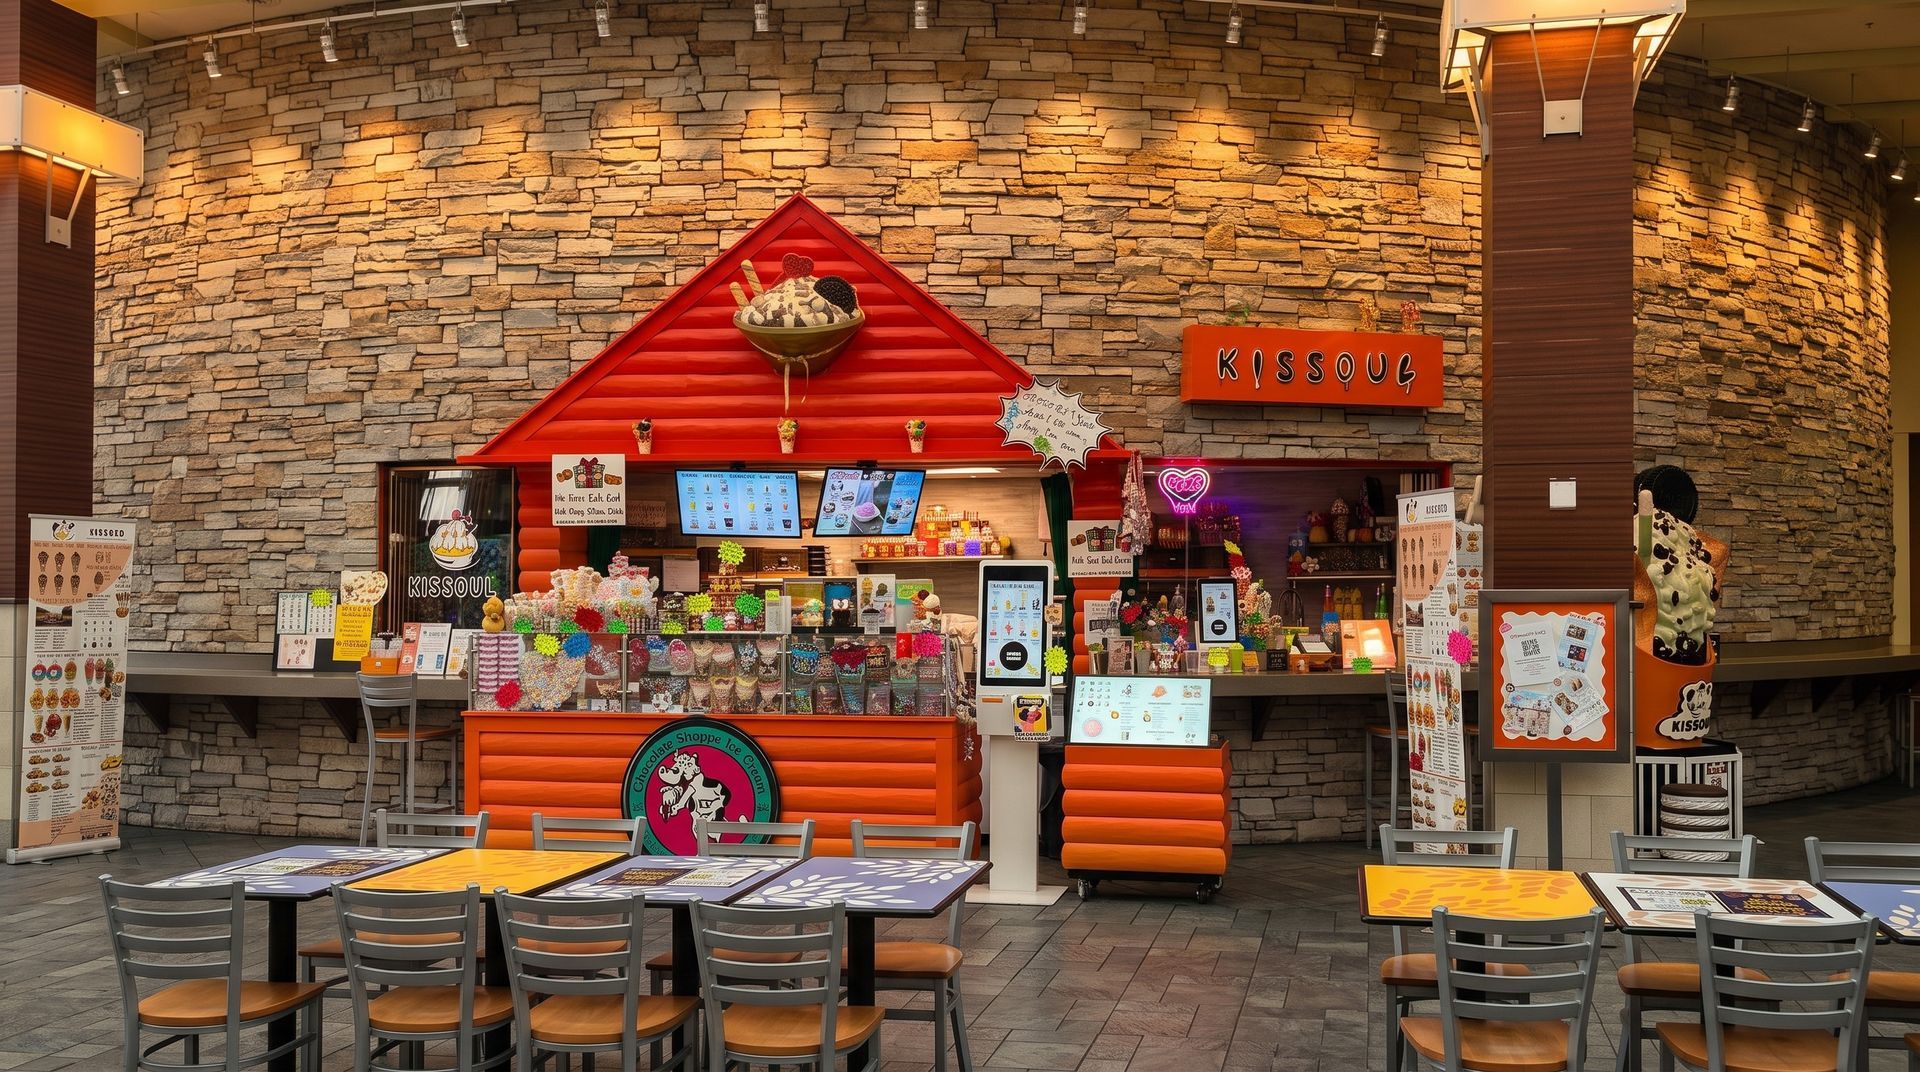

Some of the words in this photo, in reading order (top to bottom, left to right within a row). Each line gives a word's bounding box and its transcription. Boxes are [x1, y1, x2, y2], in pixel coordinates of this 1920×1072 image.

[1217, 347, 1416, 394] KISSOUL
[408, 575, 497, 598] KISSOUL
[633, 740, 673, 793] Chocolate
[676, 732, 722, 744] Shoppe
[725, 737, 742, 756] Ice
[743, 754, 765, 794] Cream
